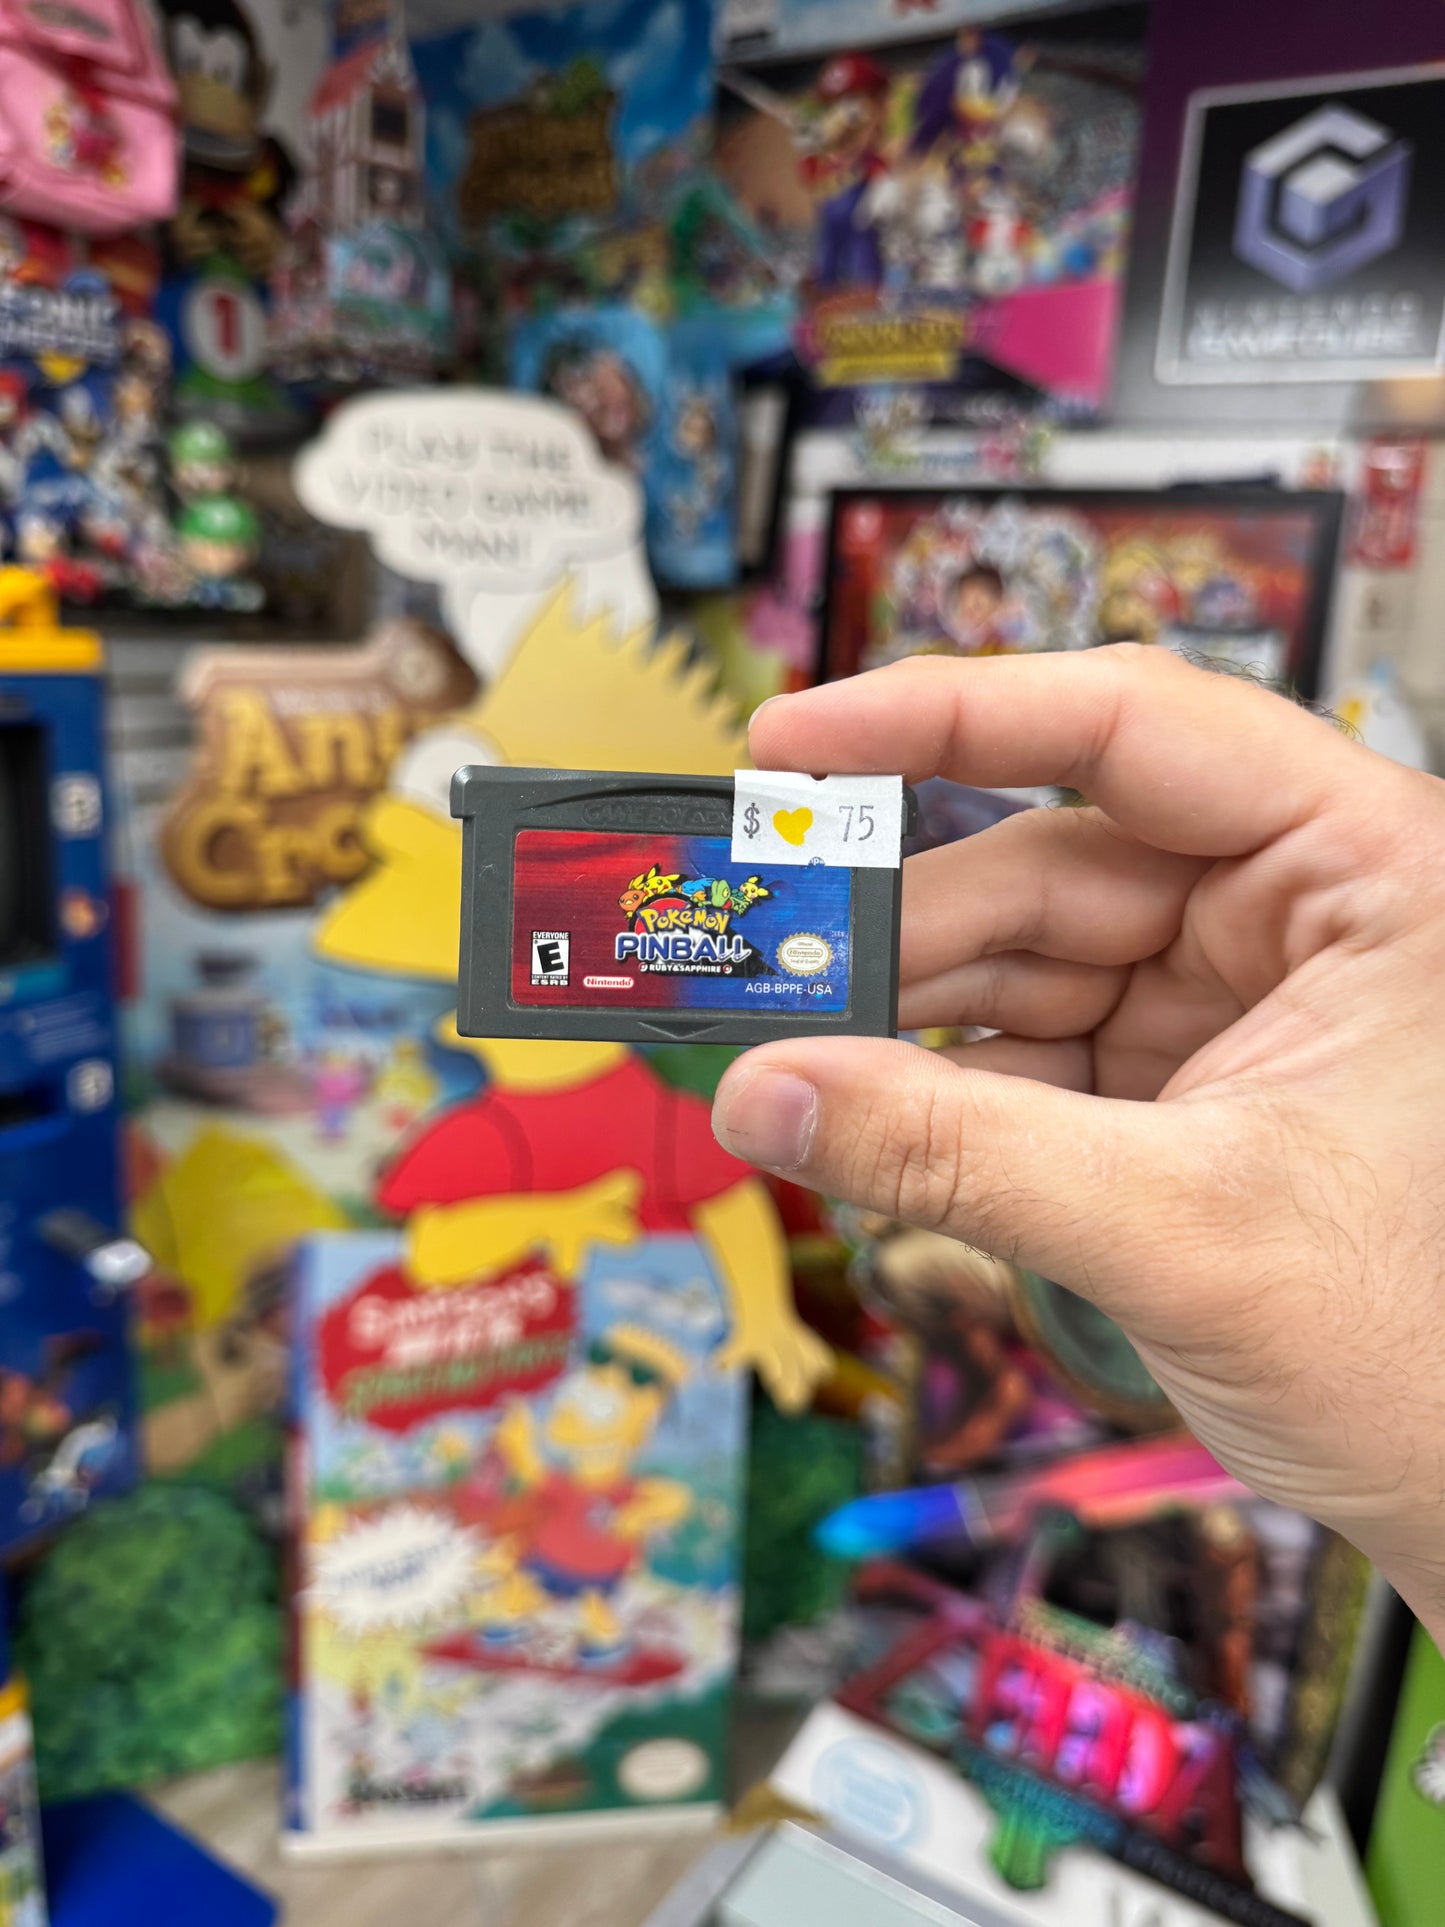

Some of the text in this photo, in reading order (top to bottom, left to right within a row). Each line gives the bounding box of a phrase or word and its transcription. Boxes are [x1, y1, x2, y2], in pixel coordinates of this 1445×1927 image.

[584, 804, 641, 825] GAME
[743, 802, 875, 842] $ 75
[532, 931, 569, 940] EVERYONE
[537, 941, 565, 973] E
[615, 933, 752, 962] PINBALL
[586, 977, 632, 987] Nintendo
[744, 982, 833, 995] AGB-BPPE-USA
